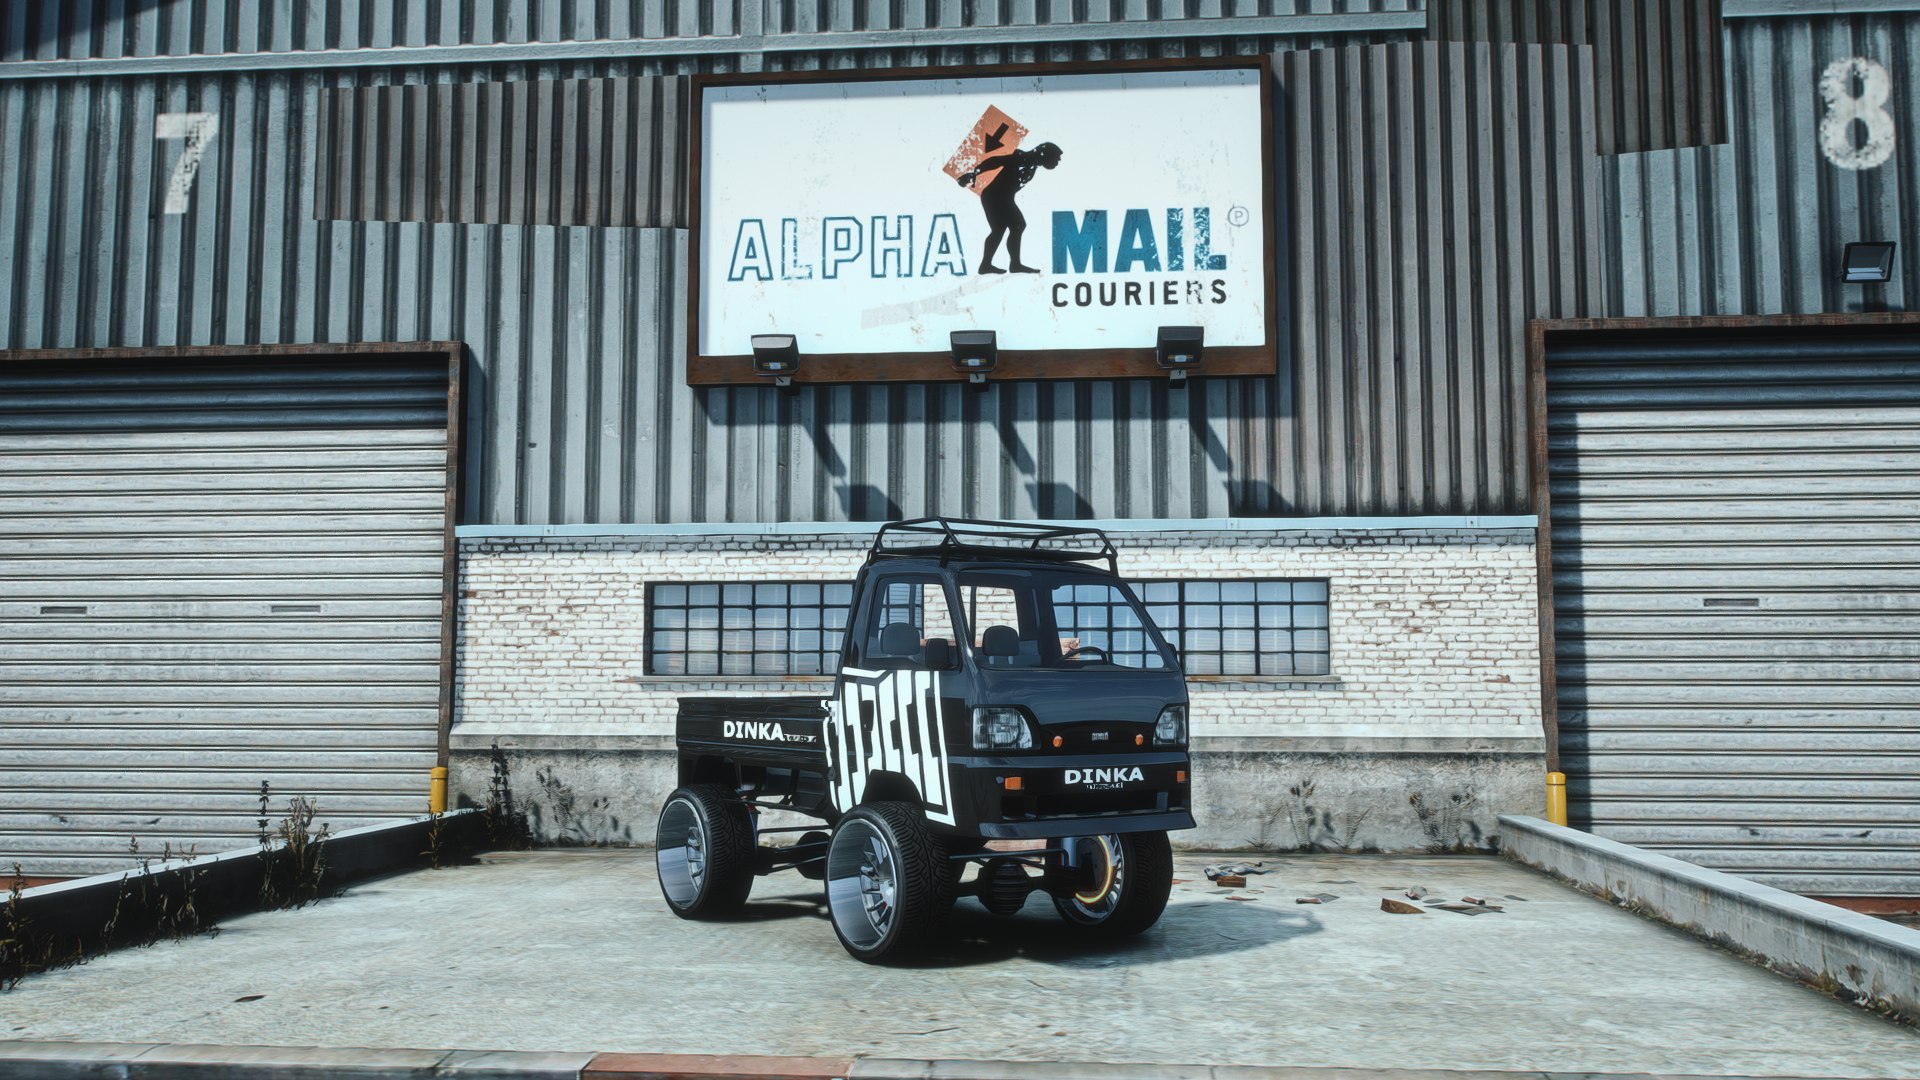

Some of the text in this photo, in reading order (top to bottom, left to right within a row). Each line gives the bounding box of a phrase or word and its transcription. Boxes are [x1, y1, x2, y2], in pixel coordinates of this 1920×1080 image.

[1818, 57, 1895, 170] 8
[155, 113, 219, 214] 7
[727, 213, 968, 282] ALPHA
[1052, 207, 1228, 274] MAIL
[1052, 279, 1227, 307] COURIERS
[723, 720, 785, 742] DINKA
[1064, 767, 1145, 785] DINKA
